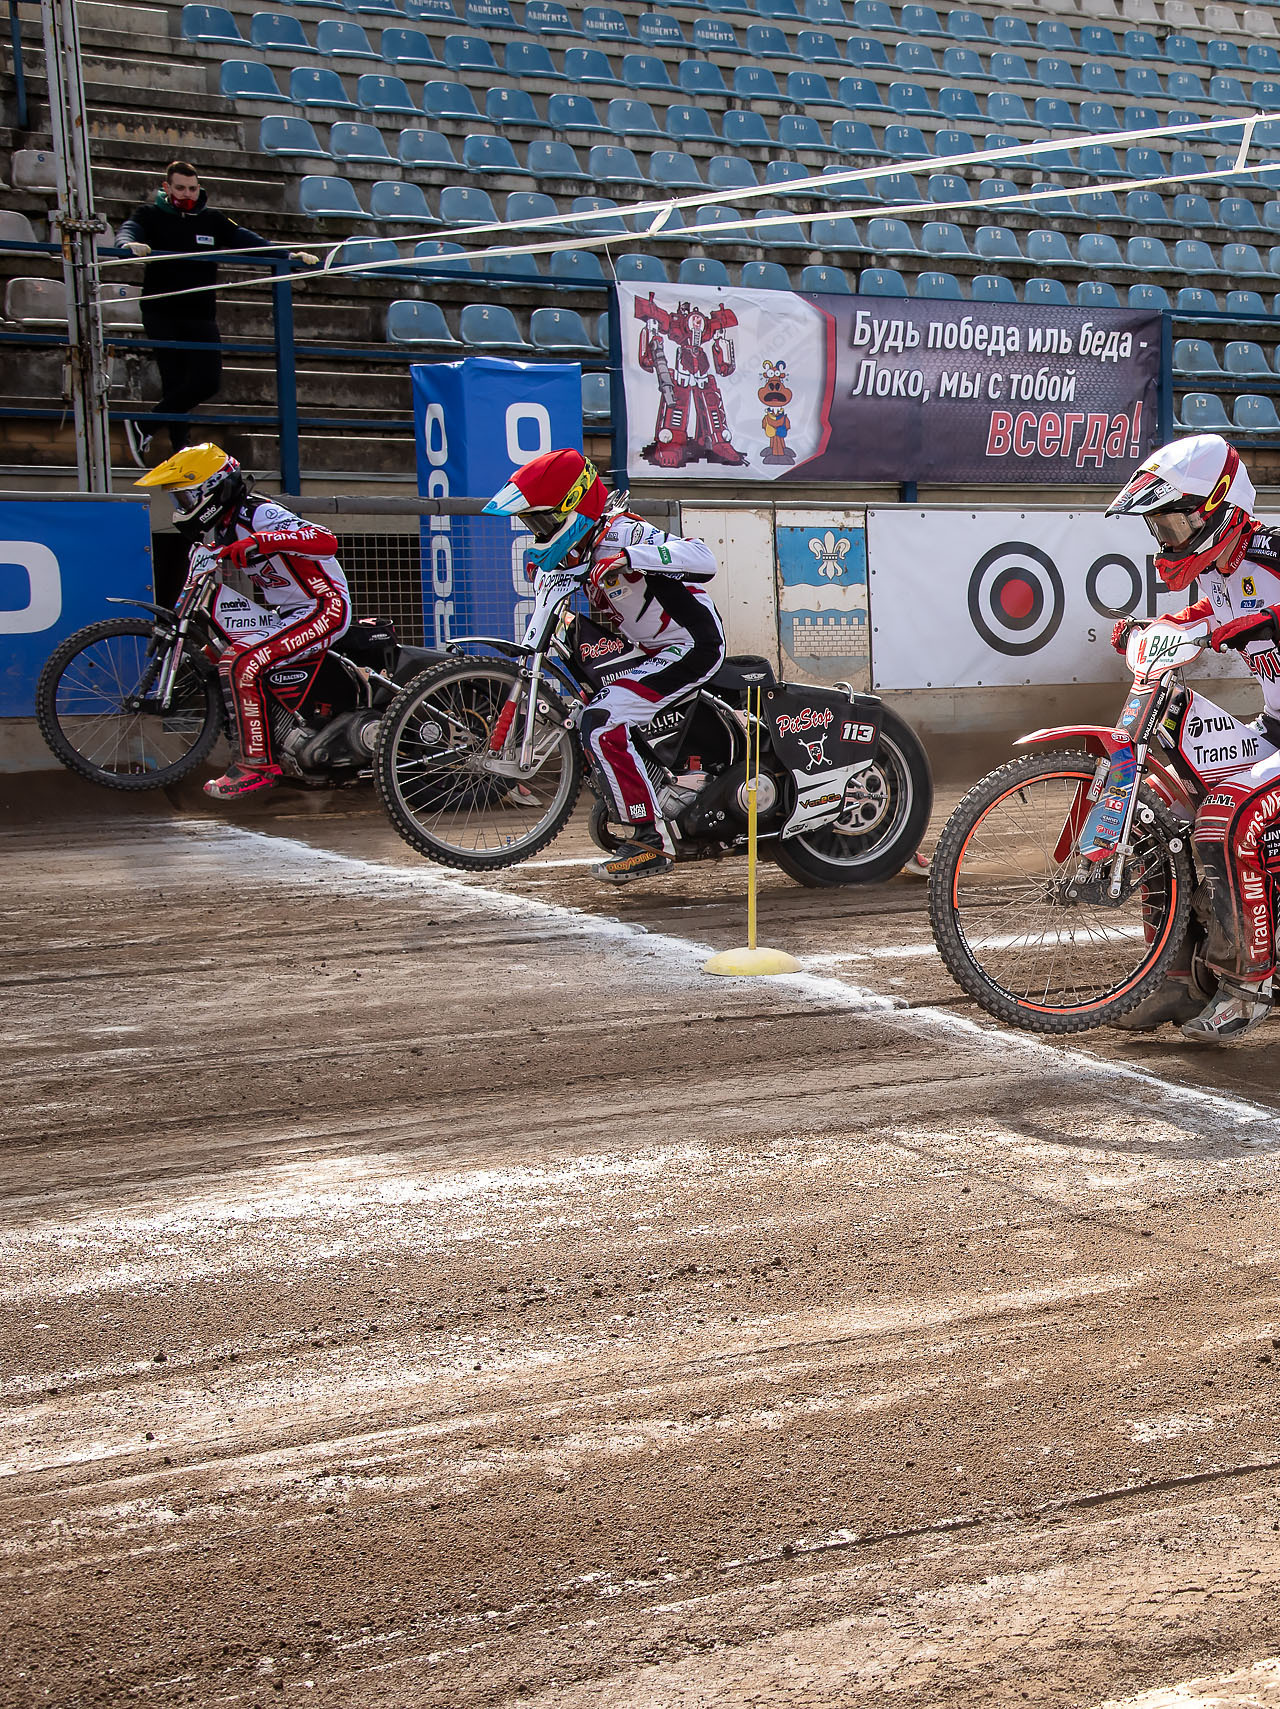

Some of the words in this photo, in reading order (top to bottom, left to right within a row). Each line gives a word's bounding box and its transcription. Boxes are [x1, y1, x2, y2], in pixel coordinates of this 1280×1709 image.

[853, 310, 920, 355] Будь
[927, 316, 1020, 357] победа
[1027, 327, 1073, 355] иль
[1078, 322, 1134, 363] беда
[852, 359, 931, 404] Локо,
[939, 370, 982, 398] мы
[988, 372, 1004, 399] с
[1009, 366, 1077, 402] тобой
[986, 400, 1143, 467] всегда!
[260, 531, 298, 543] Trans
[224, 616, 256, 629] Trans
[259, 614, 273, 627] MF
[281, 628, 316, 652] Trans
[312, 615, 331, 636] MF
[253, 646, 273, 666] MF
[579, 637, 625, 662] PitStop
[1149, 635, 1182, 657] BAU
[244, 698, 259, 718] MF
[776, 707, 834, 738] PitStop
[842, 723, 875, 743] 113
[1204, 716, 1235, 735] TULI
[249, 719, 264, 755] Trans
[1194, 743, 1238, 765] Trans
[1242, 737, 1260, 756] MF
[1091, 779, 1104, 798] STS
[1268, 849, 1279, 857] FP
[1243, 871, 1264, 901] MF
[1249, 903, 1268, 959] Trans
